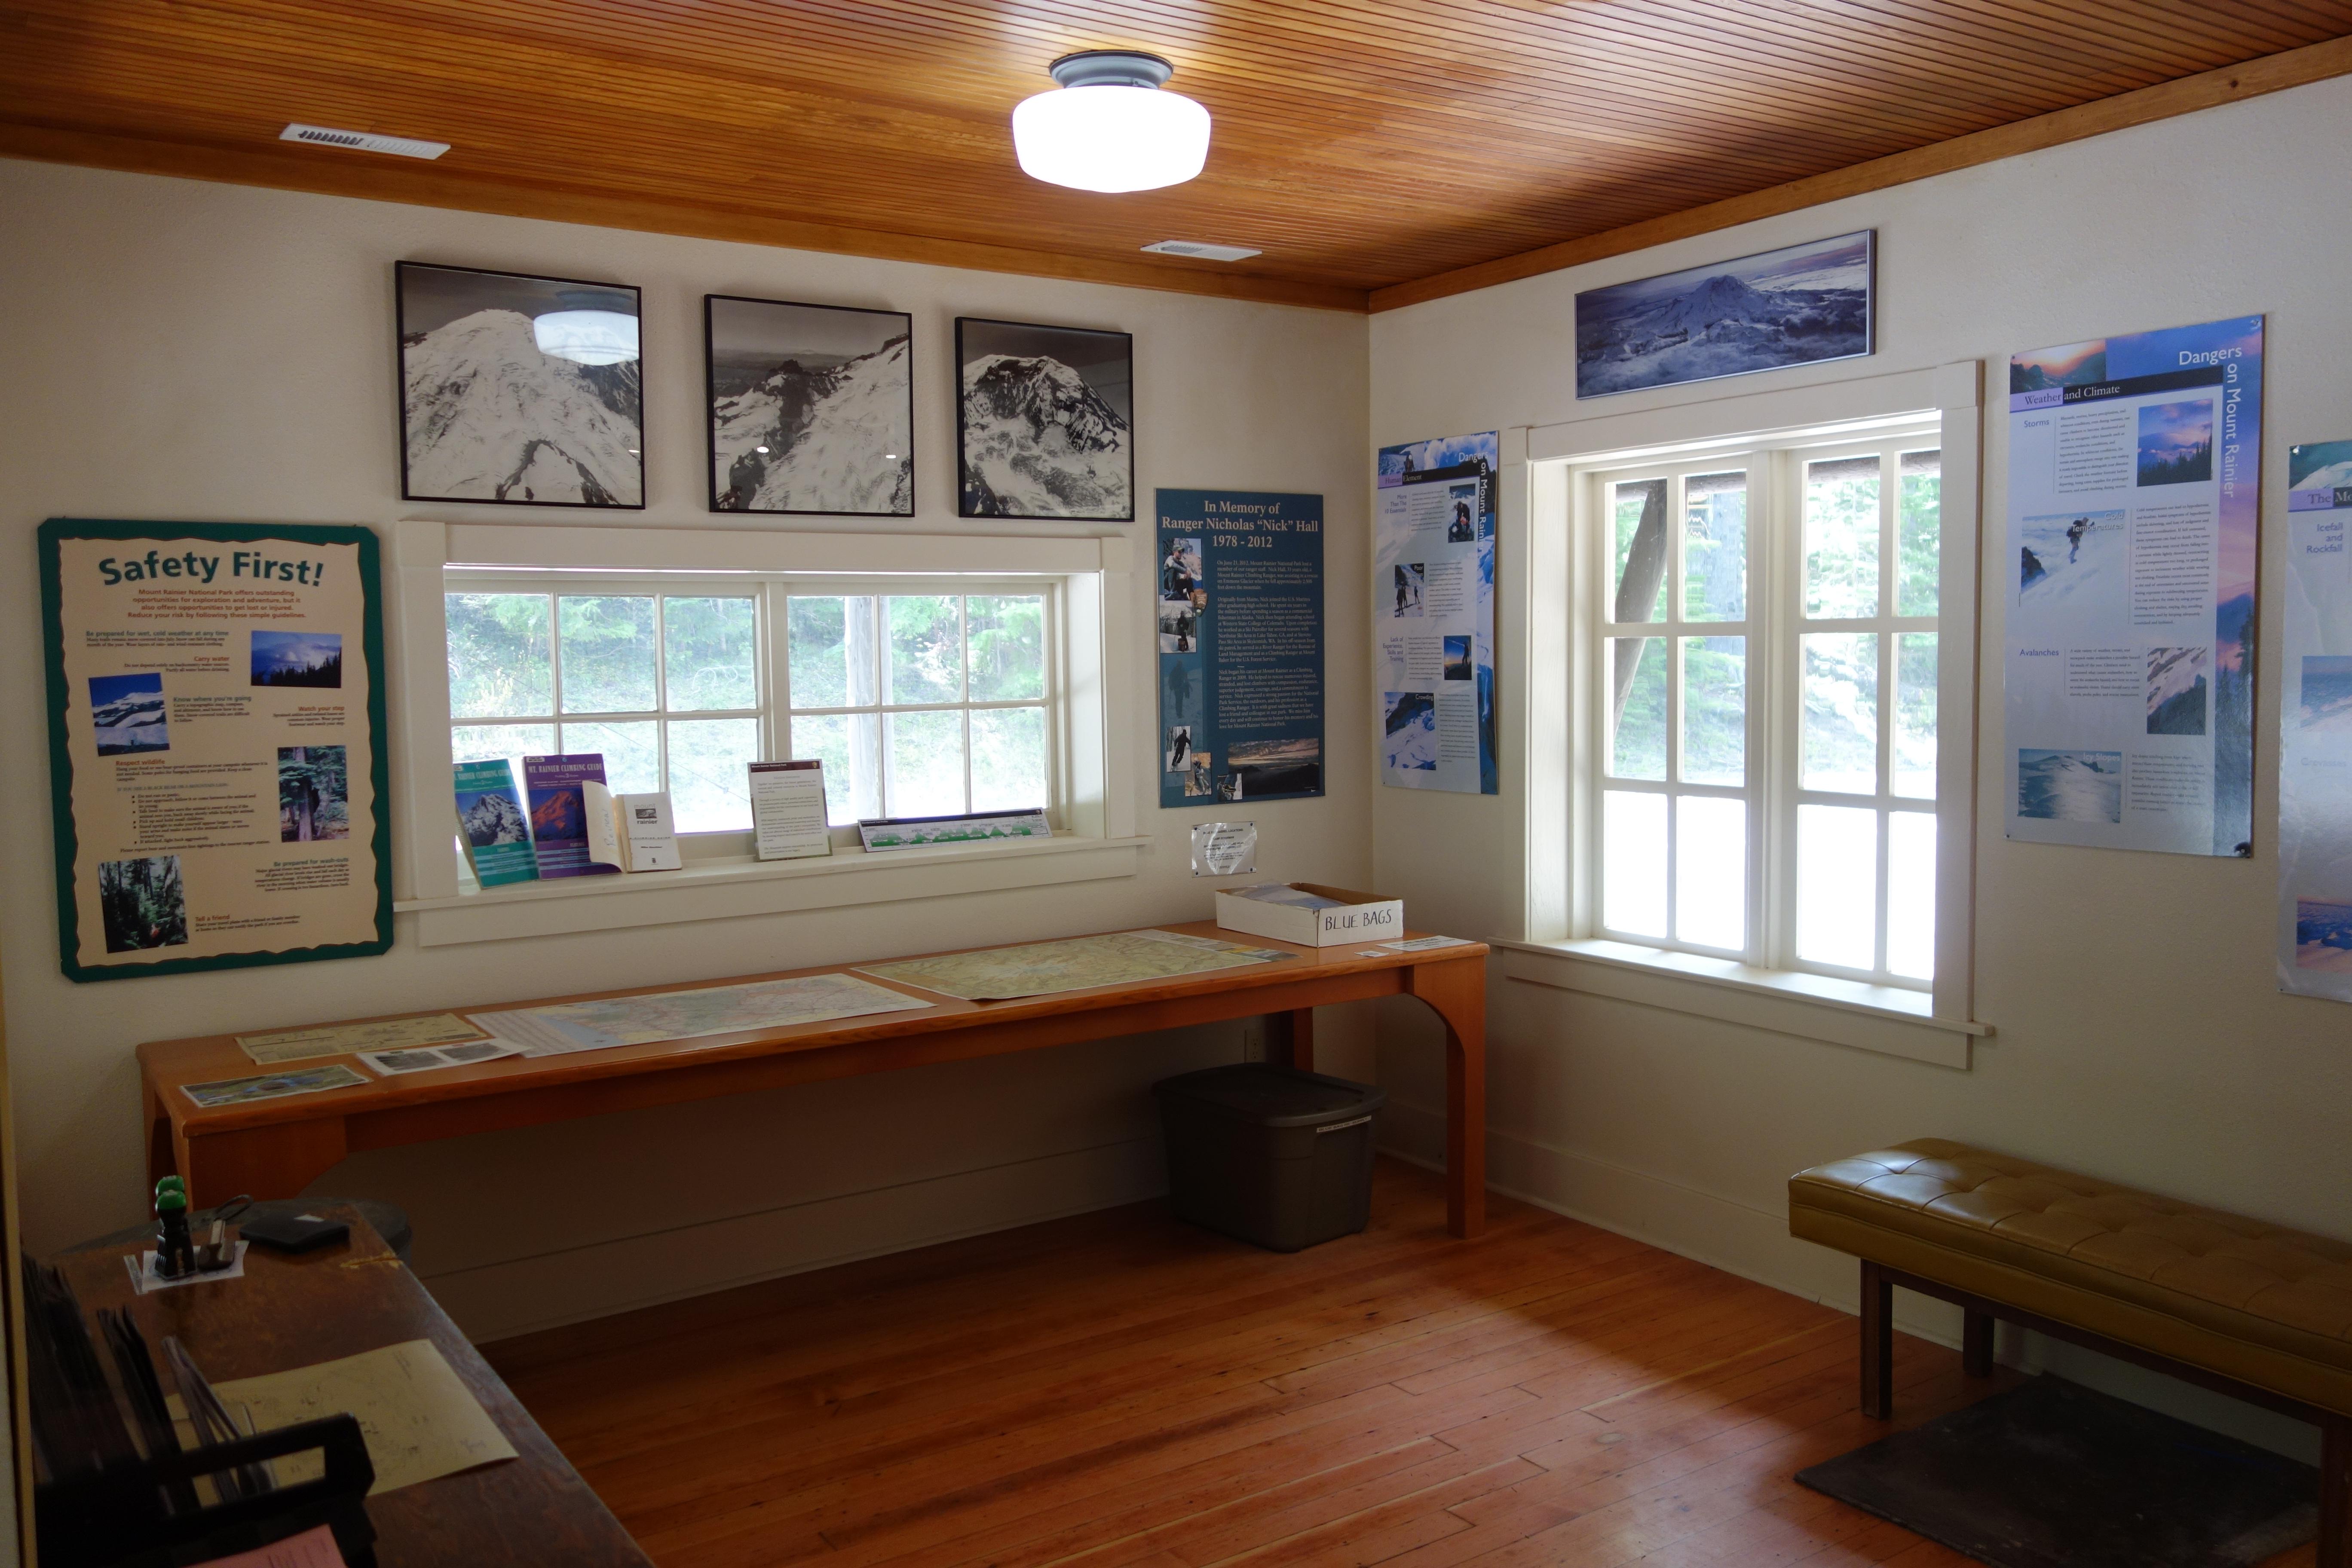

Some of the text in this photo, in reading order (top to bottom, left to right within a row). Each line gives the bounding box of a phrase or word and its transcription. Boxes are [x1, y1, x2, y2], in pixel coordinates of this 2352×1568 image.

[2179, 346, 2242, 365] Dangers
[2024, 385, 2120, 404] Weather and Climate
[2024, 419, 2049, 427] Storms
[2224, 364, 2241, 498] on Mount Rainier
[1459, 451, 1488, 463] Dangers
[1481, 462, 1486, 476] on
[2308, 494, 2331, 504] The
[1205, 501, 1280, 516] In Memory of
[1162, 517, 1318, 532] Ranger Nicholas “Nick” Hall
[2072, 522, 2123, 533] Temperatures
[2317, 523, 2343, 531] Icefall
[1213, 536, 1237, 546] 1978
[1248, 536, 1272, 547] 2012
[2326, 533, 2343, 542] and
[2307, 544, 2342, 553] Rockfall
[99, 551, 324, 587] Safety First!
[2083, 752, 2120, 763] Icy Slopes
[1326, 909, 1391, 930] BLUE BAGS
